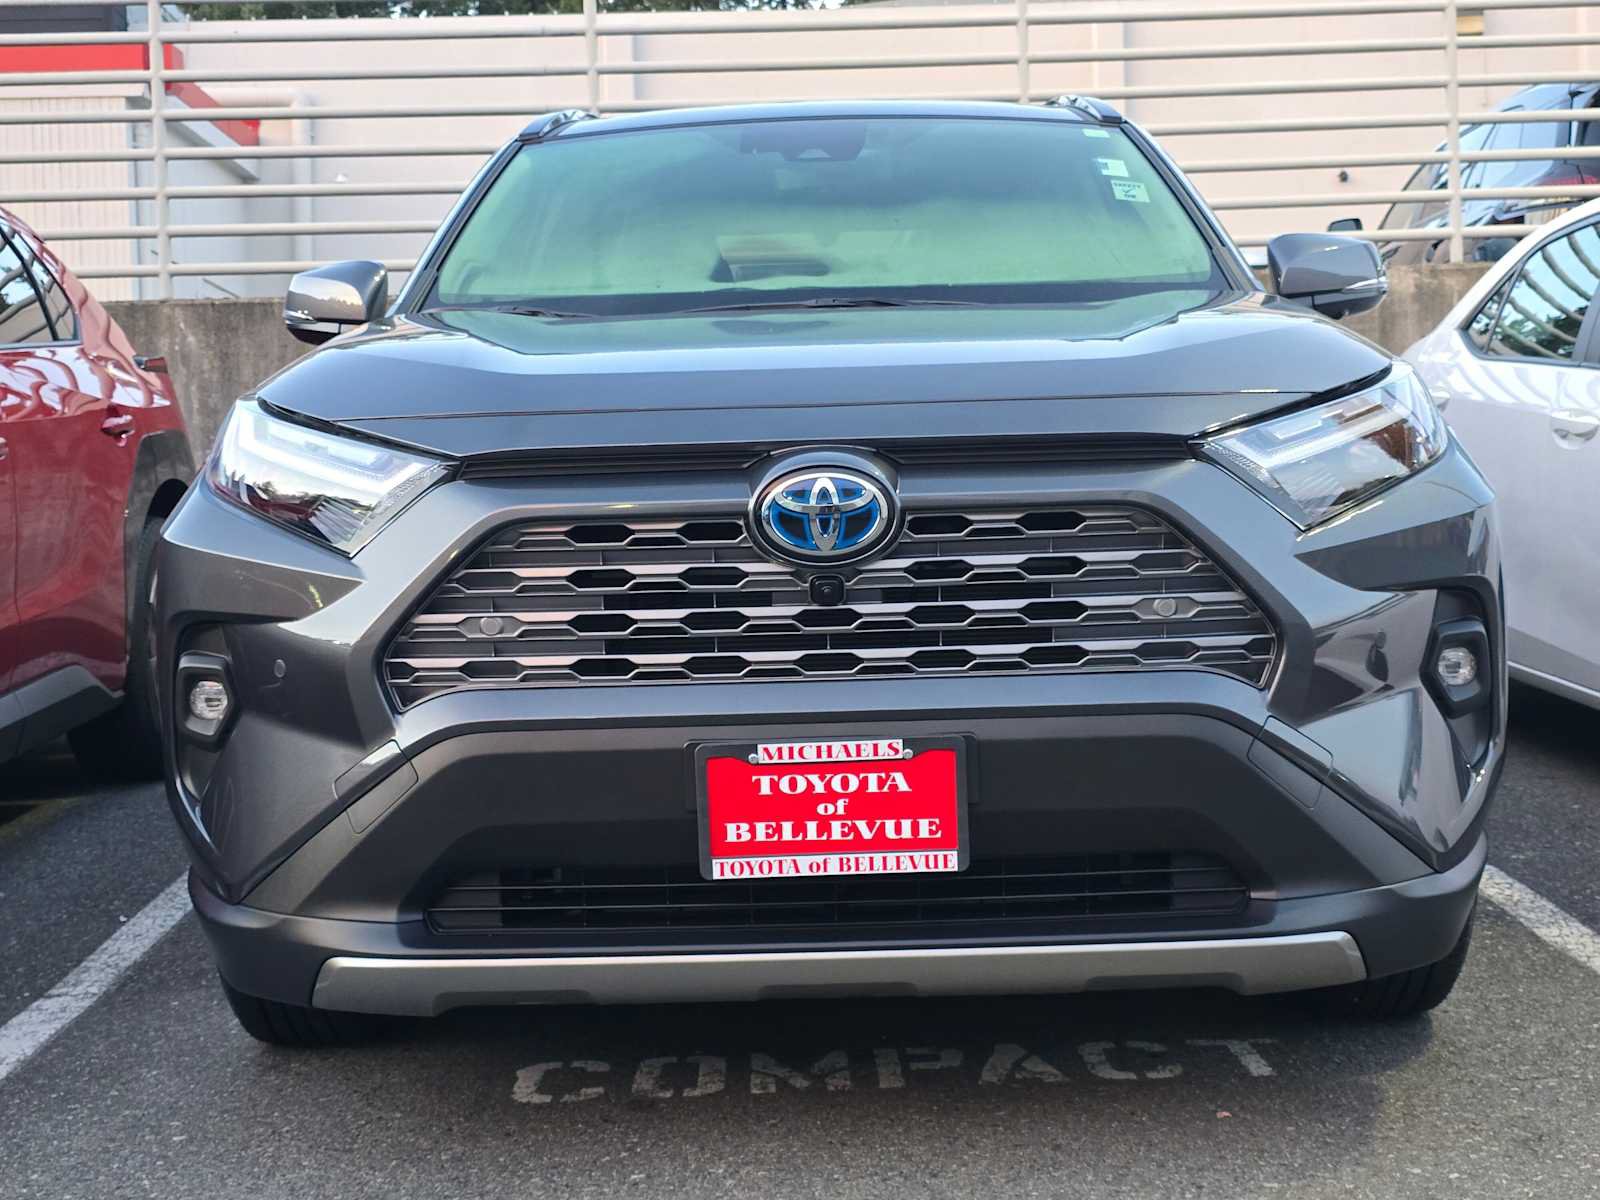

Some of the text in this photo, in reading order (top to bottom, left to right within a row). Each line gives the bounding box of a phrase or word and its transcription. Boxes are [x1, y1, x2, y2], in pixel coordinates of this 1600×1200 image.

[761, 741, 901, 761] MICHAELS
[752, 771, 913, 795] TOYOTA
[816, 798, 849, 816] of
[723, 817, 943, 843] BELLEVUE
[715, 853, 956, 877] TOYOTA of BELLEVUE
[511, 1037, 1278, 1104] COMPACT
